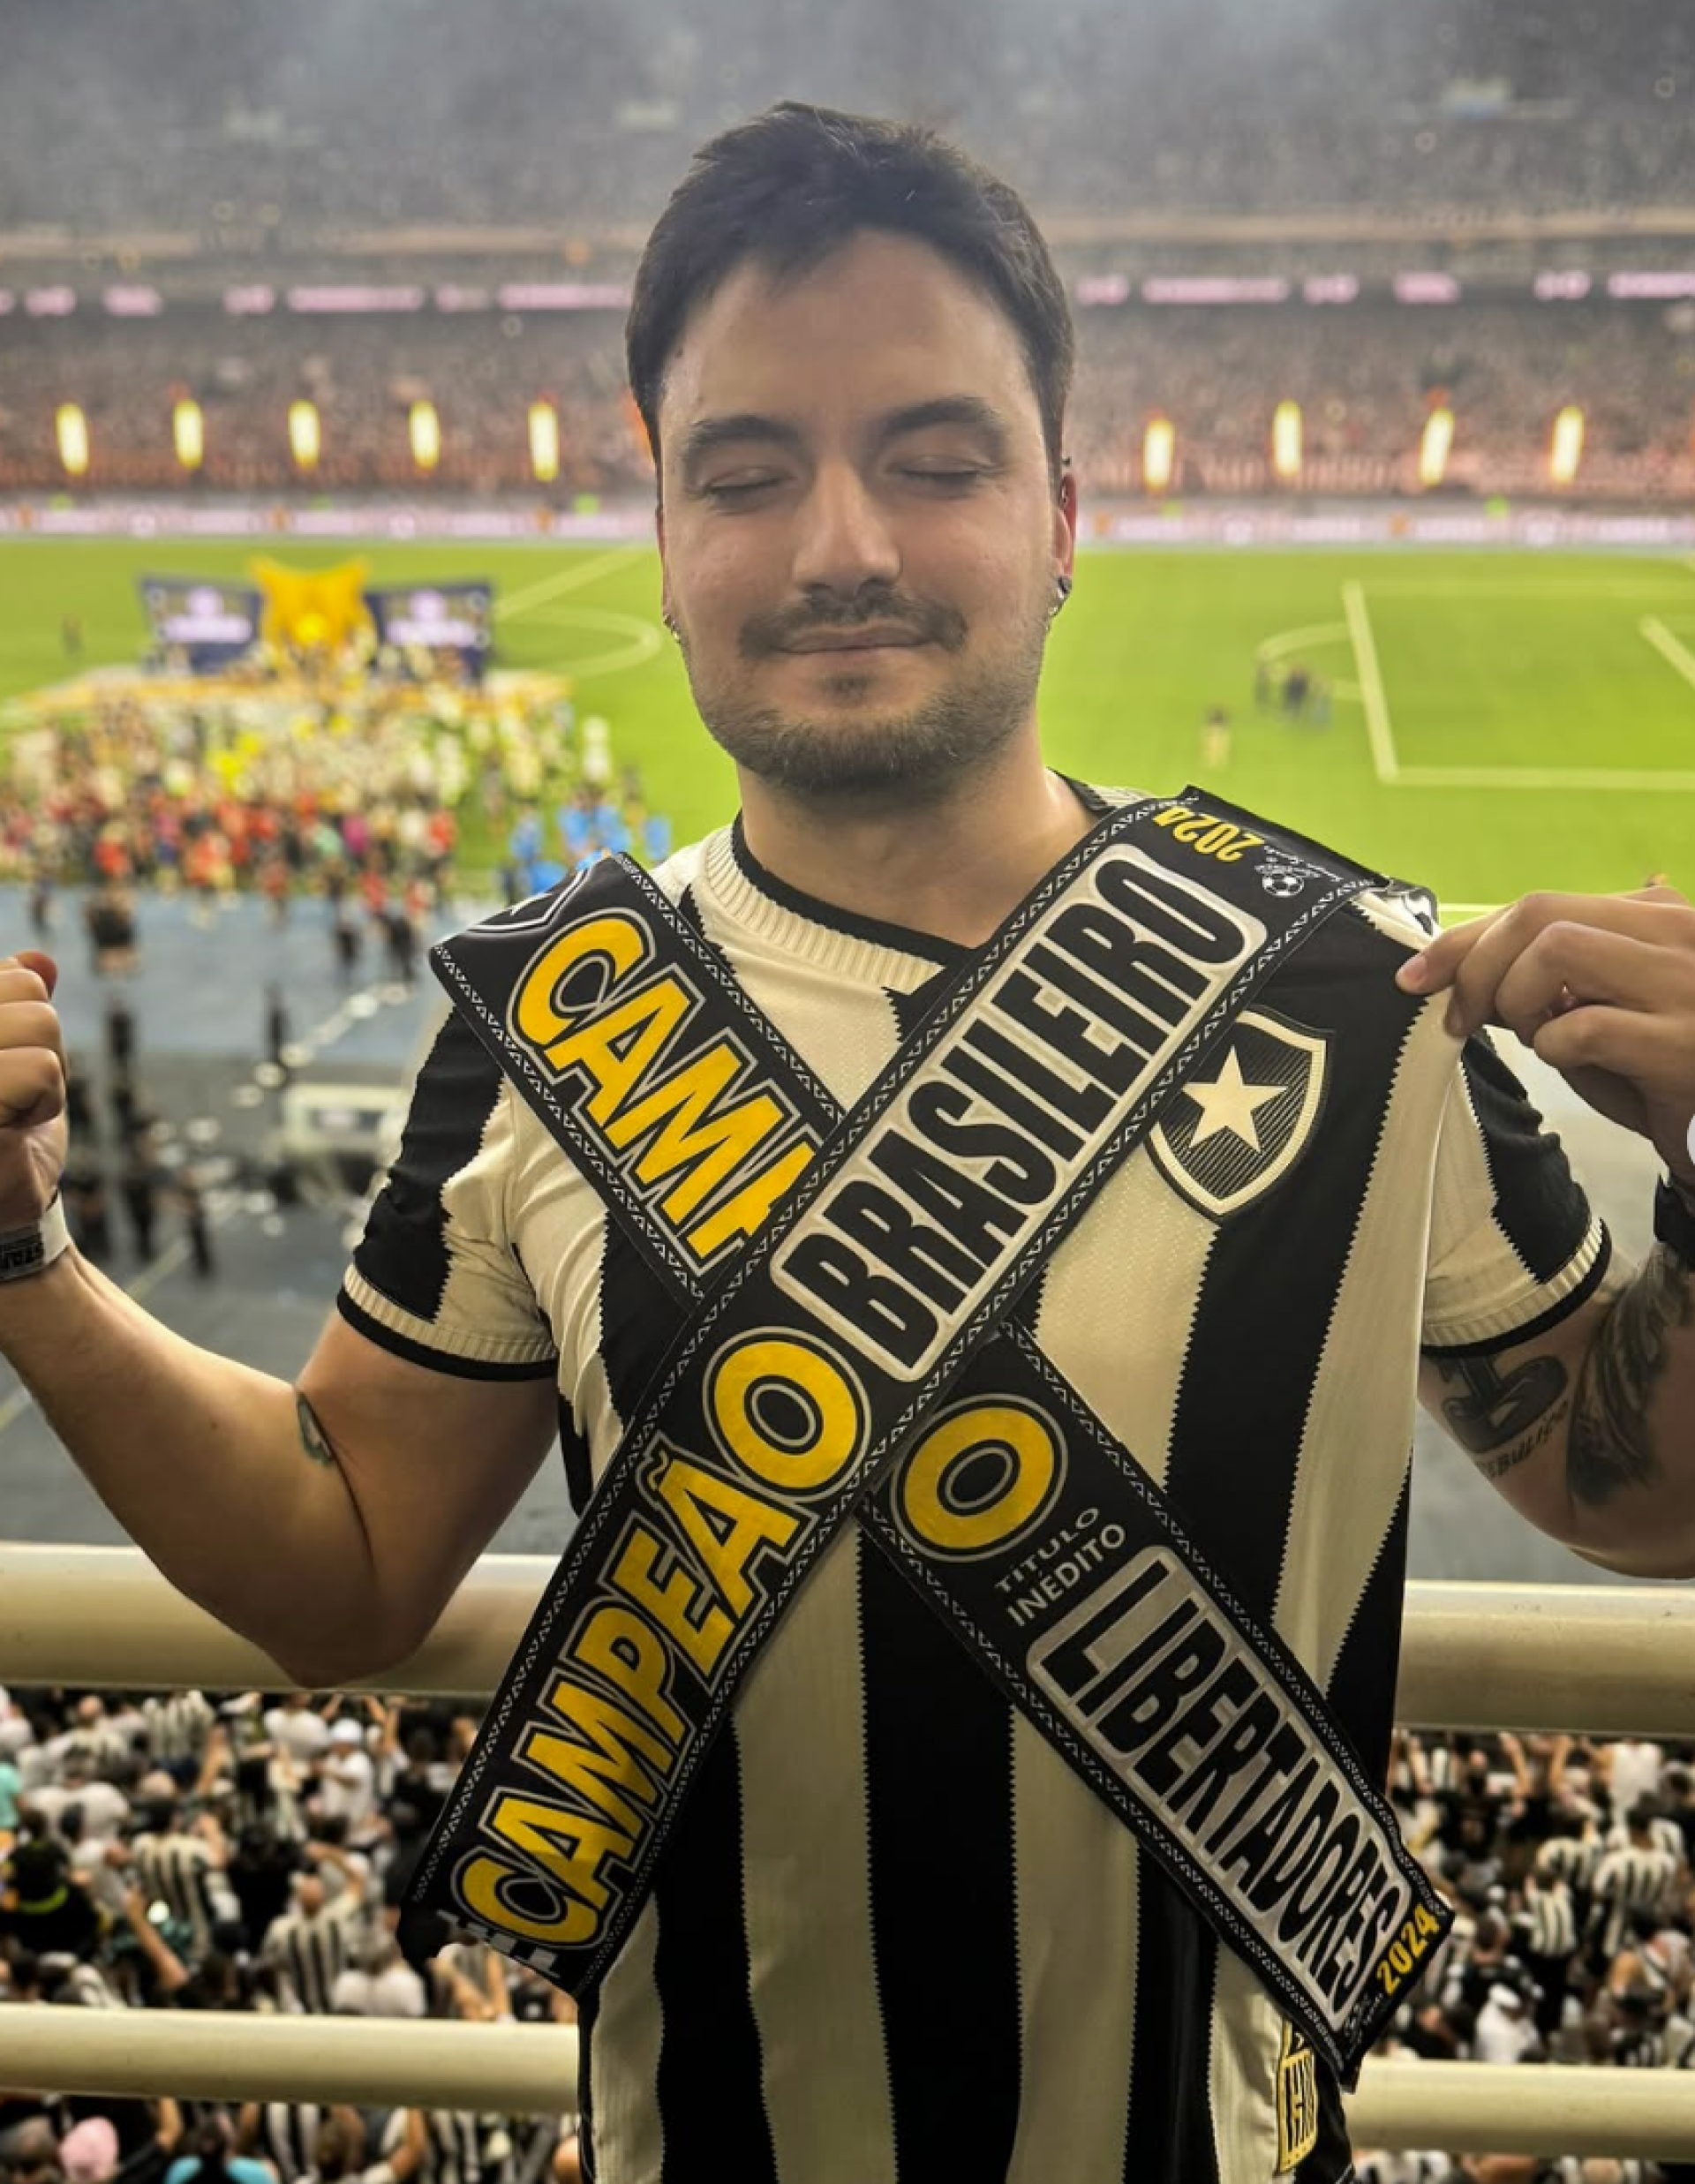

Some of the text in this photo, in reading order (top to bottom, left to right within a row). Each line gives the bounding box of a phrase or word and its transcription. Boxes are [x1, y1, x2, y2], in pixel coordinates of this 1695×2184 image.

[454, 857, 1246, 1947] CAMPEÃO BRASILEIRO
[1006, 1524, 1126, 1627] INÉDITO
[1039, 1557, 1402, 2015] LIBERTADORES
[1375, 1902, 1442, 1997] 2024
